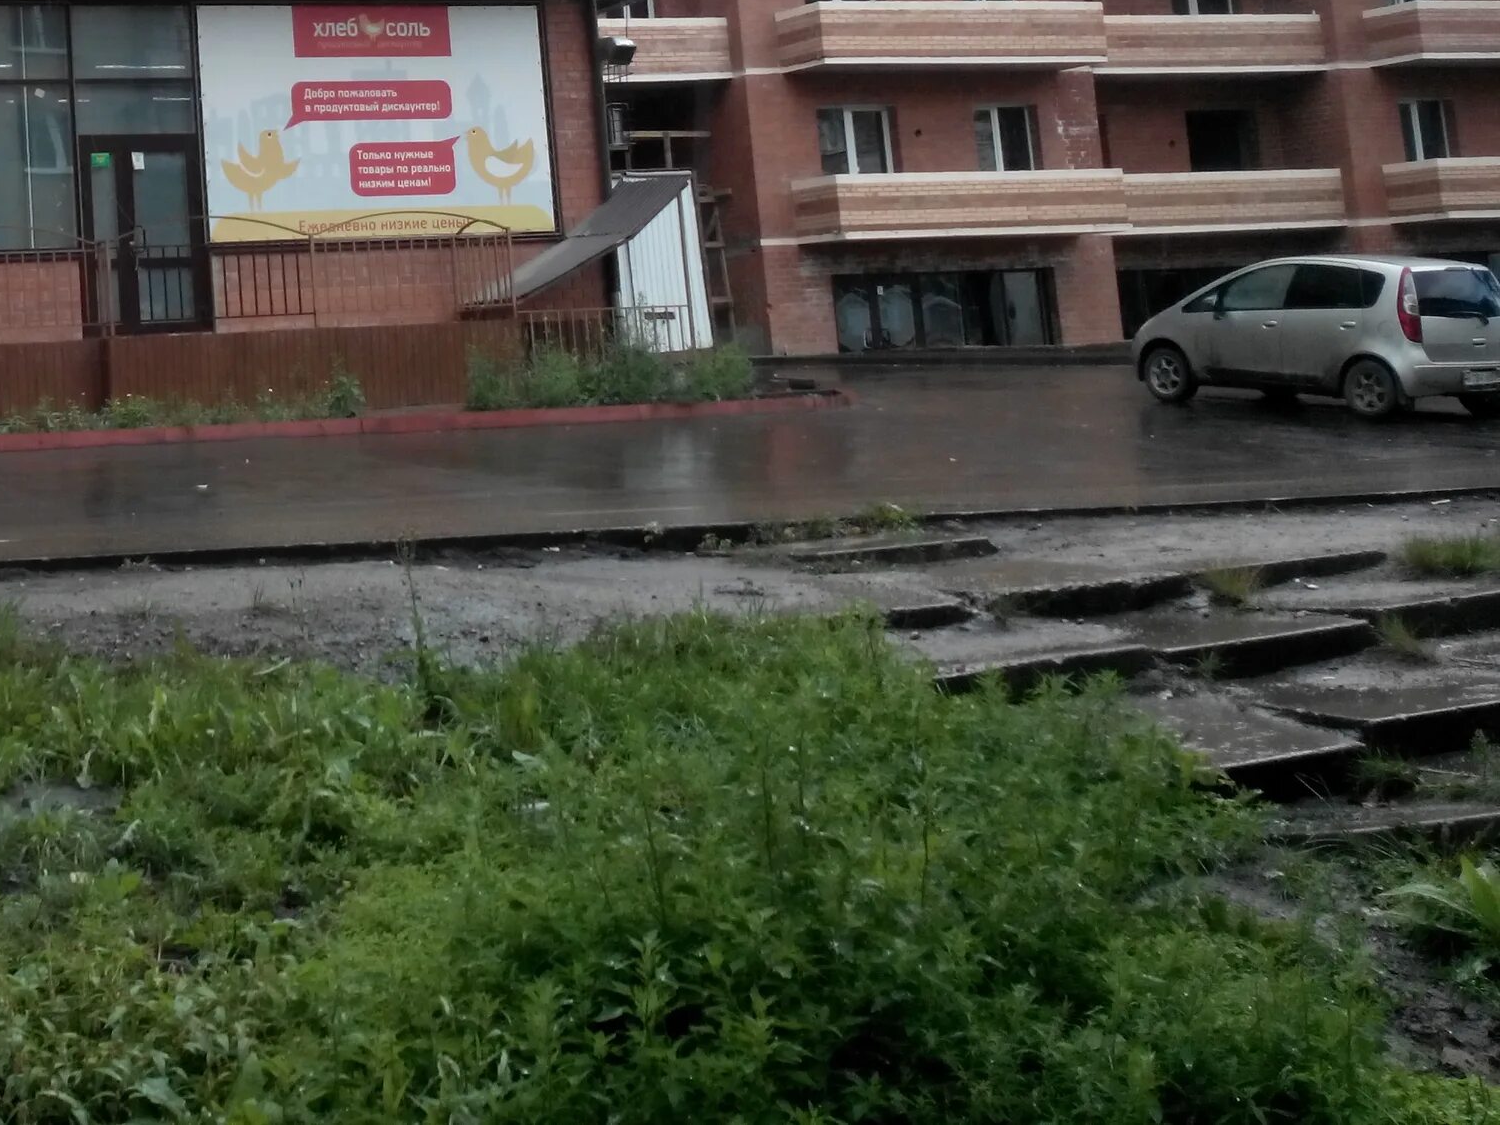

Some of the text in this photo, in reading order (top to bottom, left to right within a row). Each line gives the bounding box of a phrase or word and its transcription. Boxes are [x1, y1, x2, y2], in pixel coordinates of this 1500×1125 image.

[312, 17, 431, 37] хлеб соль
[304, 88, 397, 100] Добро пожаловать
[305, 100, 441, 114] в продуктовый дискаунтер!
[356, 150, 434, 161] Только нужные
[357, 164, 451, 176] товары по реально
[358, 177, 432, 189] низким ценам!
[299, 220, 376, 233] Ежедневно
[380, 219, 428, 231] низкие
